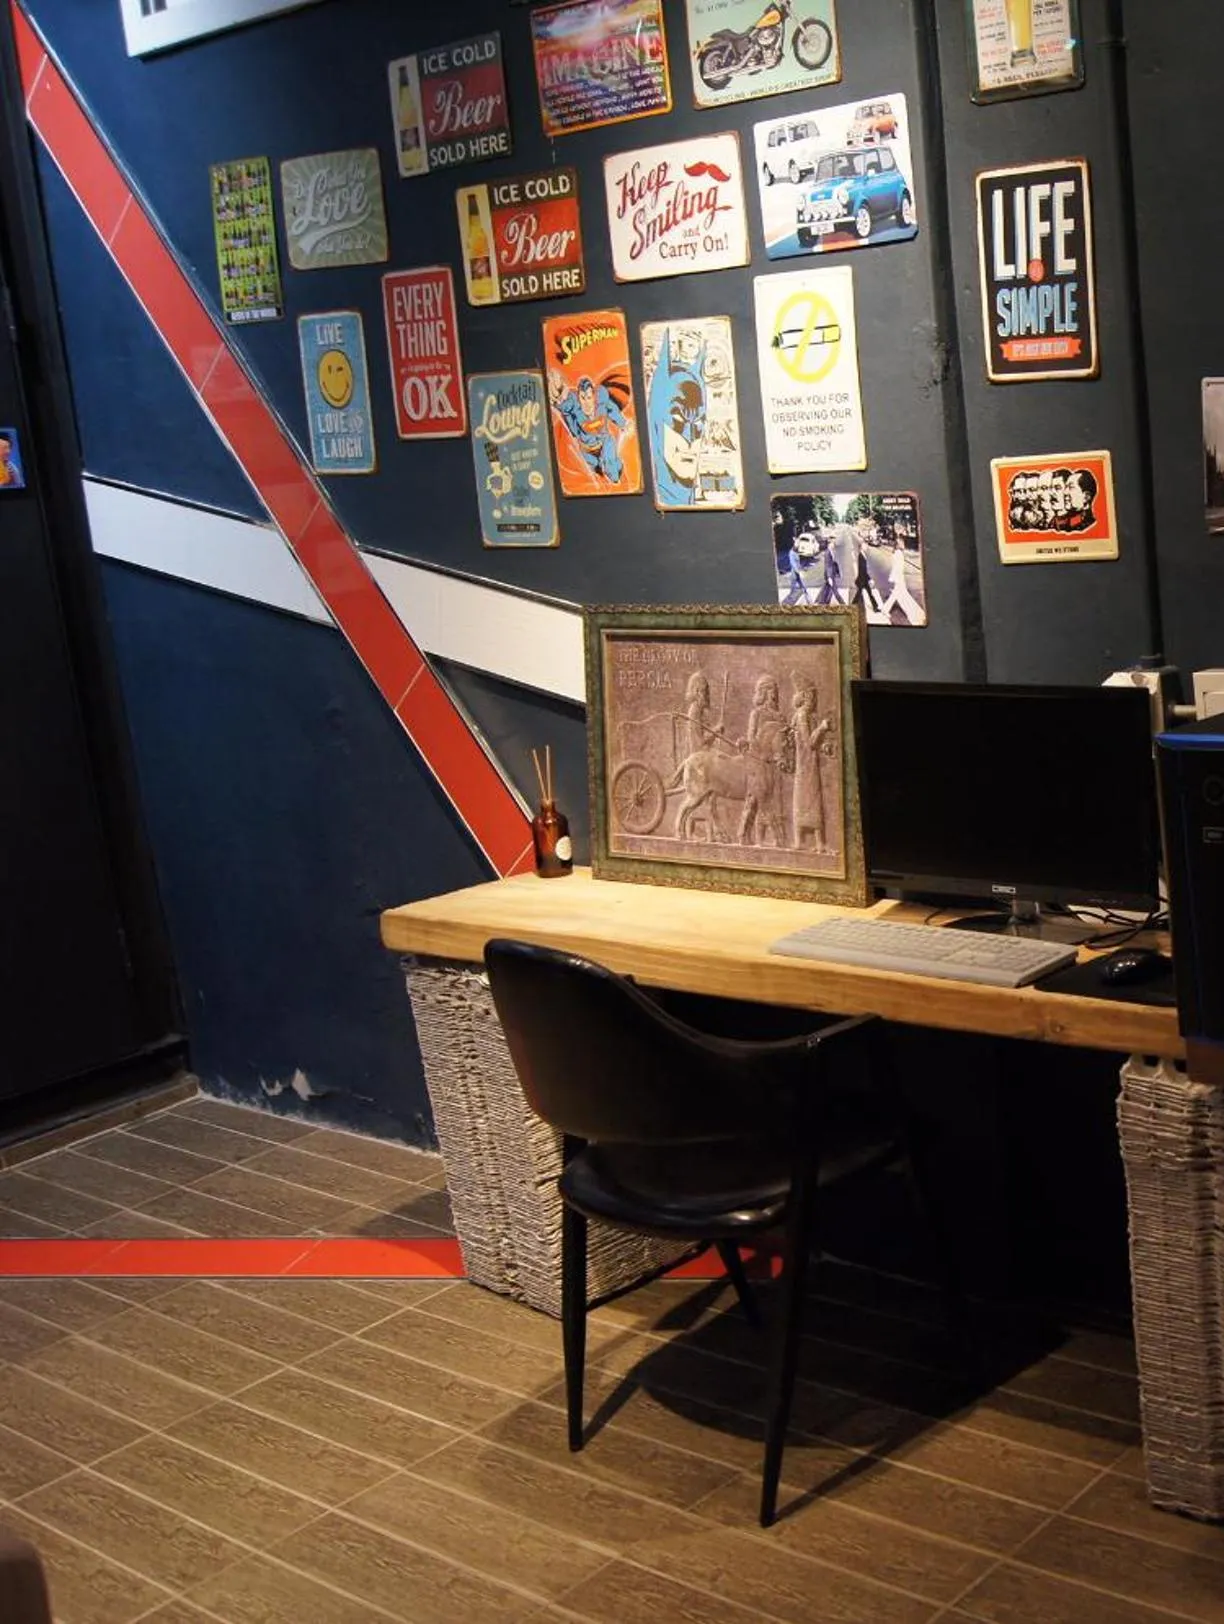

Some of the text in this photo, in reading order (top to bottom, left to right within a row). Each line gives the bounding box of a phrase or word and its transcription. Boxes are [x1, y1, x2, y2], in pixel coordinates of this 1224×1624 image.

[423, 40, 497, 74] ICE COLD
[429, 80, 502, 135] Beer
[429, 132, 509, 167] SOLD HERE
[494, 175, 571, 205] ICE COLD
[616, 161, 674, 219] Keep
[629, 180, 733, 260] Smiling
[683, 225, 700, 238] and
[991, 180, 1077, 281] LIFE
[501, 212, 576, 266] Beer
[659, 231, 729, 260] Carry On!
[502, 269, 581, 298] SOLD HERE
[392, 282, 445, 322] EVERY
[996, 282, 1079, 337] SIMPLE
[316, 323, 344, 345] LIVE
[395, 321, 448, 359] THING
[560, 327, 619, 365] SUPERMAN
[402, 374, 458, 421] OK
[497, 381, 537, 410] Cocktail
[771, 393, 849, 407] THANK YOU FOR
[317, 412, 347, 434] LOVE
[475, 394, 541, 443] Lounge
[772, 408, 852, 423] OBSERVING OUR
[783, 424, 845, 437] NO SMOKING
[321, 436, 363, 458] LAUGH
[797, 440, 832, 451] POLICY
